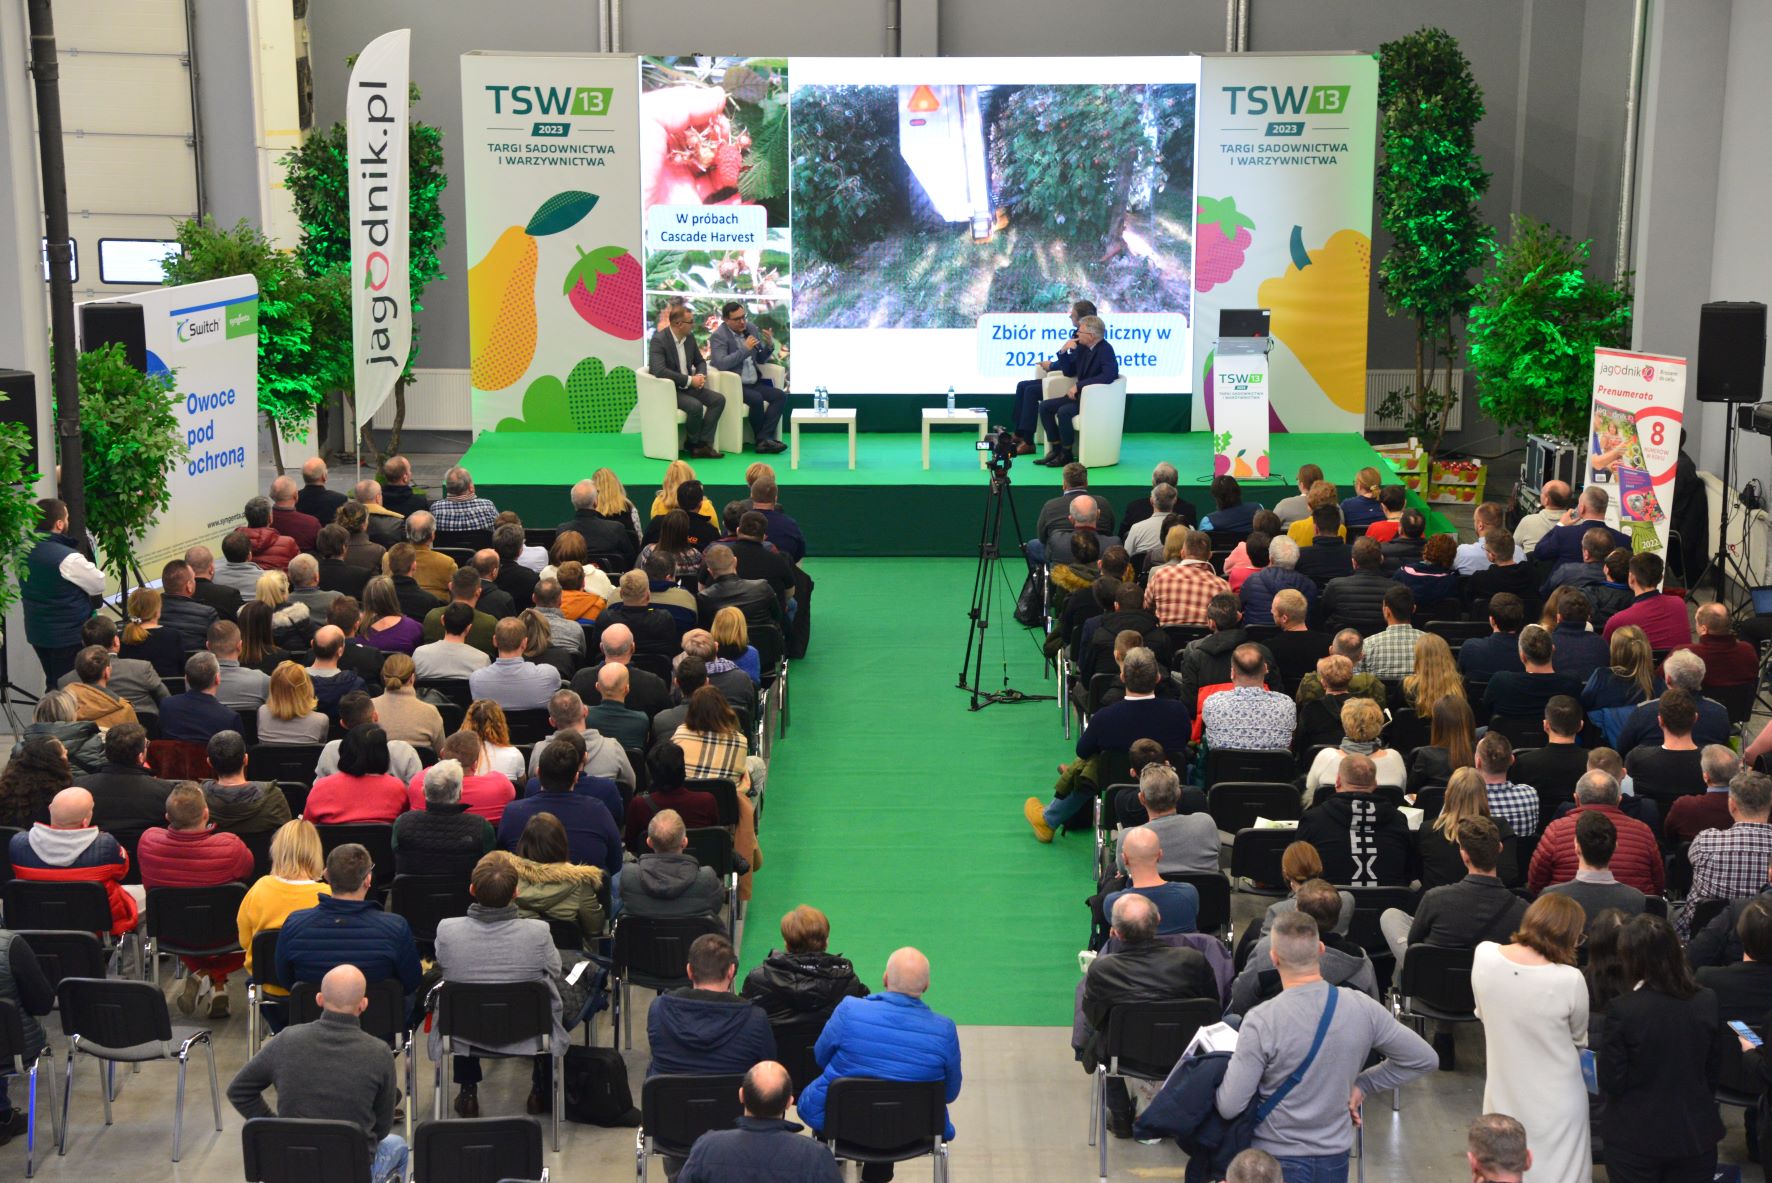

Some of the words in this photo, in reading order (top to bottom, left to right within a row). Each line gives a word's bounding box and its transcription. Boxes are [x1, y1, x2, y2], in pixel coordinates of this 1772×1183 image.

[485, 85, 572, 115] TSW
[578, 91, 604, 112] 13
[1221, 85, 1309, 115] TSW
[1315, 89, 1340, 110] 13
[538, 125, 564, 134] 2023
[1272, 124, 1297, 134] 2023
[487, 143, 522, 153] TARGI
[525, 144, 616, 154] SADOWNICTWA
[1220, 144, 1254, 153] TARGI
[1258, 143, 1349, 153] SADOWNICTWA
[498, 156, 502, 165] I
[505, 156, 606, 167] WARZYWNICTWA
[1230, 157, 1234, 166] I
[1237, 155, 1338, 166] WARZYWNICTWA
[358, 81, 398, 368] jagodnik.pl
[676, 213, 689, 224] W
[692, 212, 739, 227] próbach
[660, 231, 707, 242] Cascade
[711, 232, 755, 243] Harvest
[189, 319, 220, 337] Switch
[991, 324, 1037, 341] Zbiór
[1156, 329, 1172, 341] w
[1218, 373, 1249, 384] TSW
[1597, 384, 1654, 401] Prenumerata
[186, 388, 236, 415] Owoce
[187, 419, 214, 449] pod
[1650, 421, 1665, 446] 8
[187, 445, 245, 477] ochroną
[1641, 538, 1660, 550] 2022
